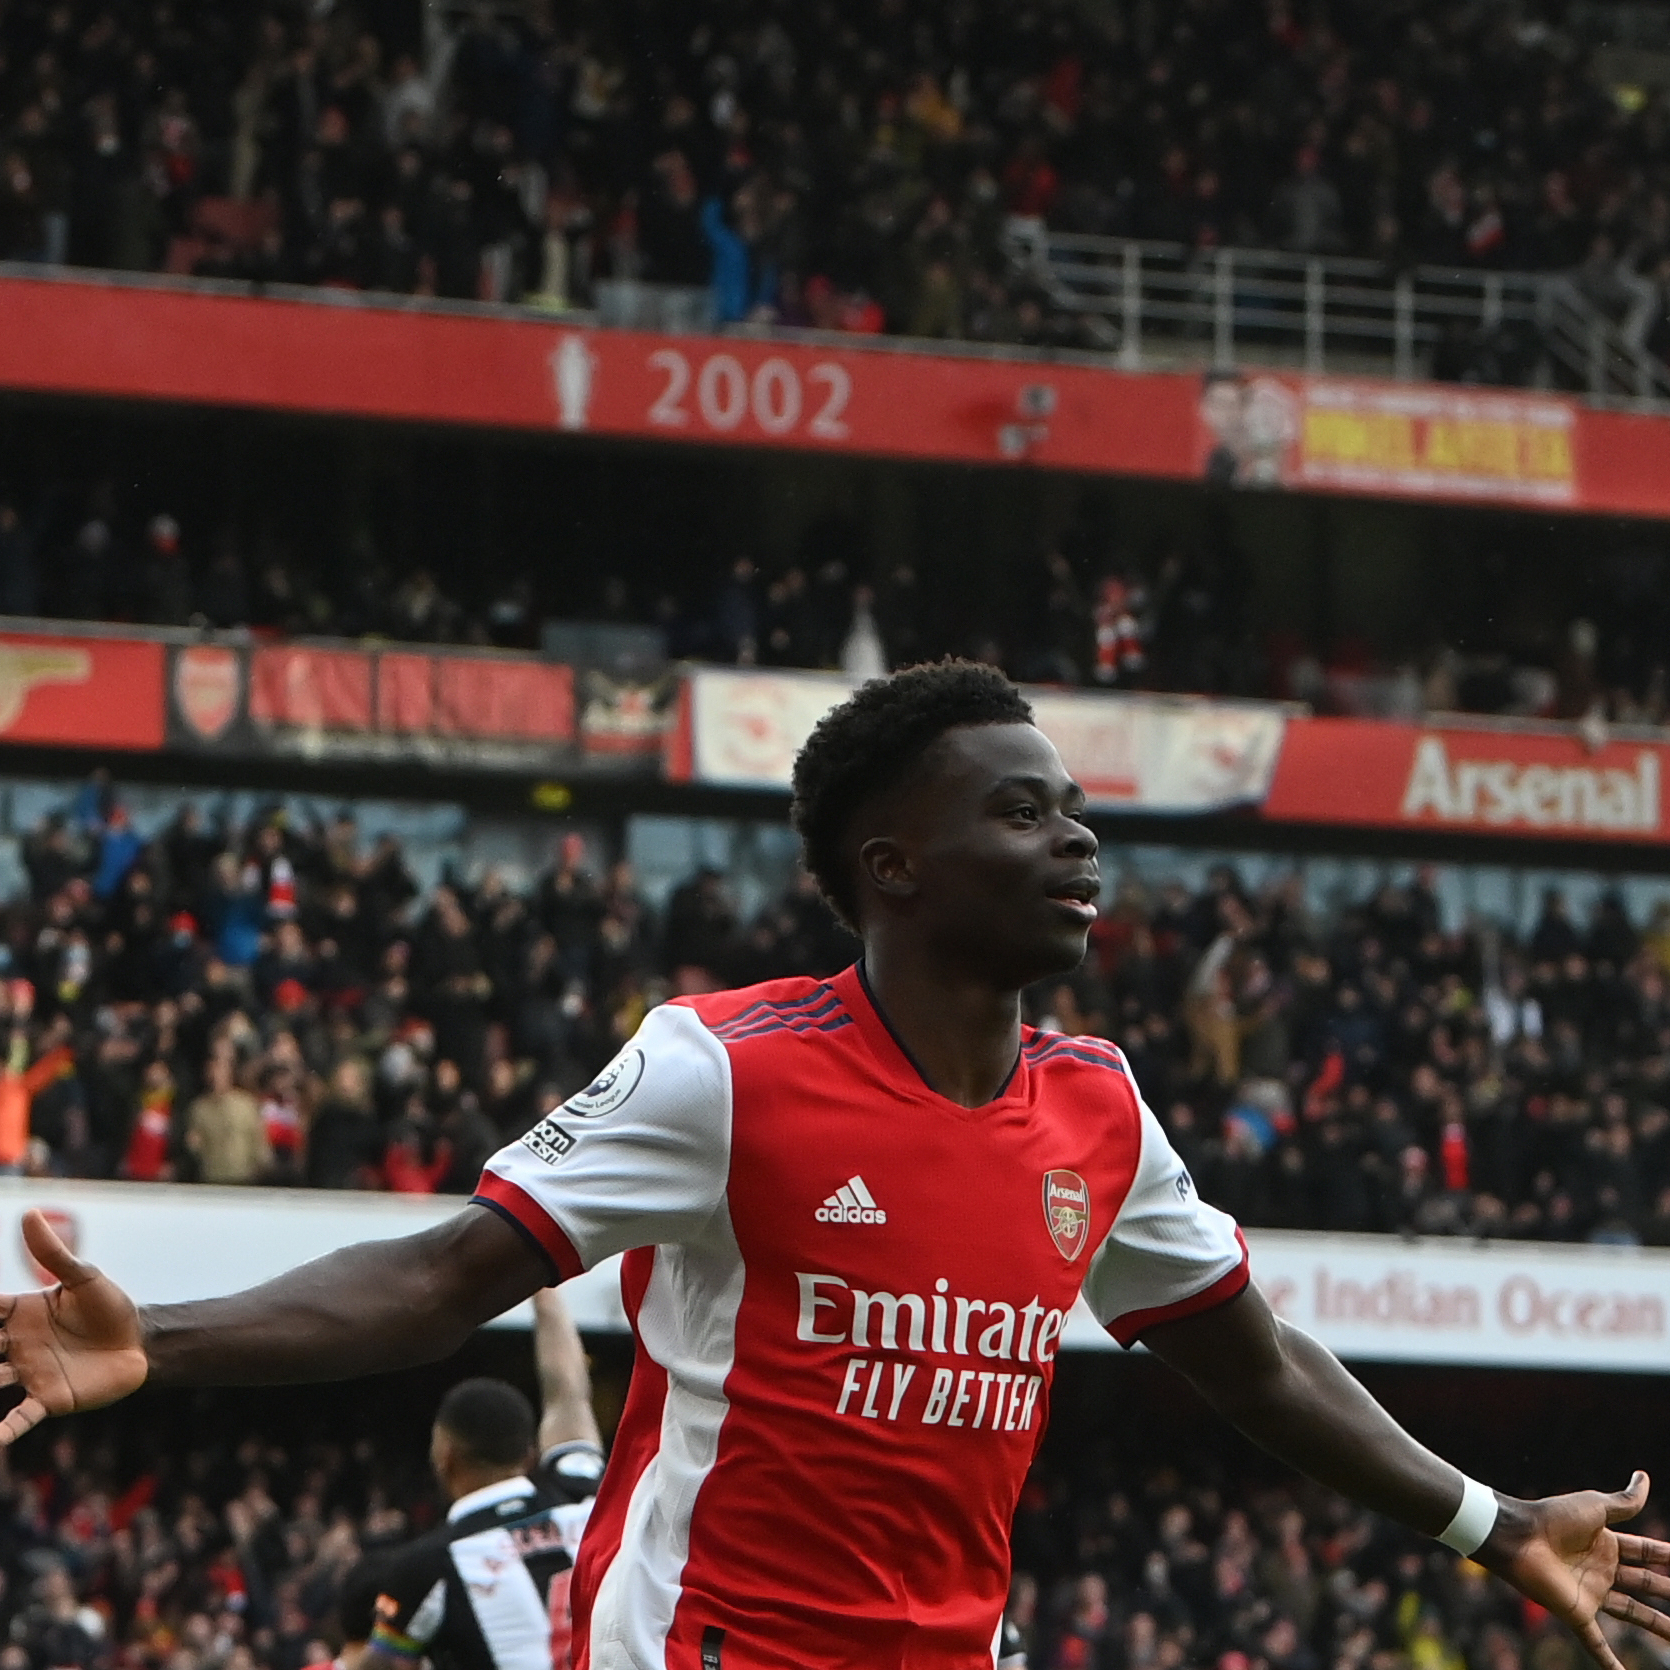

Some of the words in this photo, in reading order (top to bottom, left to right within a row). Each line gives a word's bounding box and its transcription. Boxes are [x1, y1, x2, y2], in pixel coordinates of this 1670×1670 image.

[646, 348, 854, 441] 2002
[1402, 735, 1661, 833] Arsenal
[814, 1206, 887, 1225] adidas
[1050, 1182, 1086, 1203] Arsenal
[1312, 1263, 1483, 1330] Indian
[1497, 1271, 1668, 1340] Ocean
[835, 1358, 917, 1421] FLY
[921, 1367, 1043, 1431] BETTER
